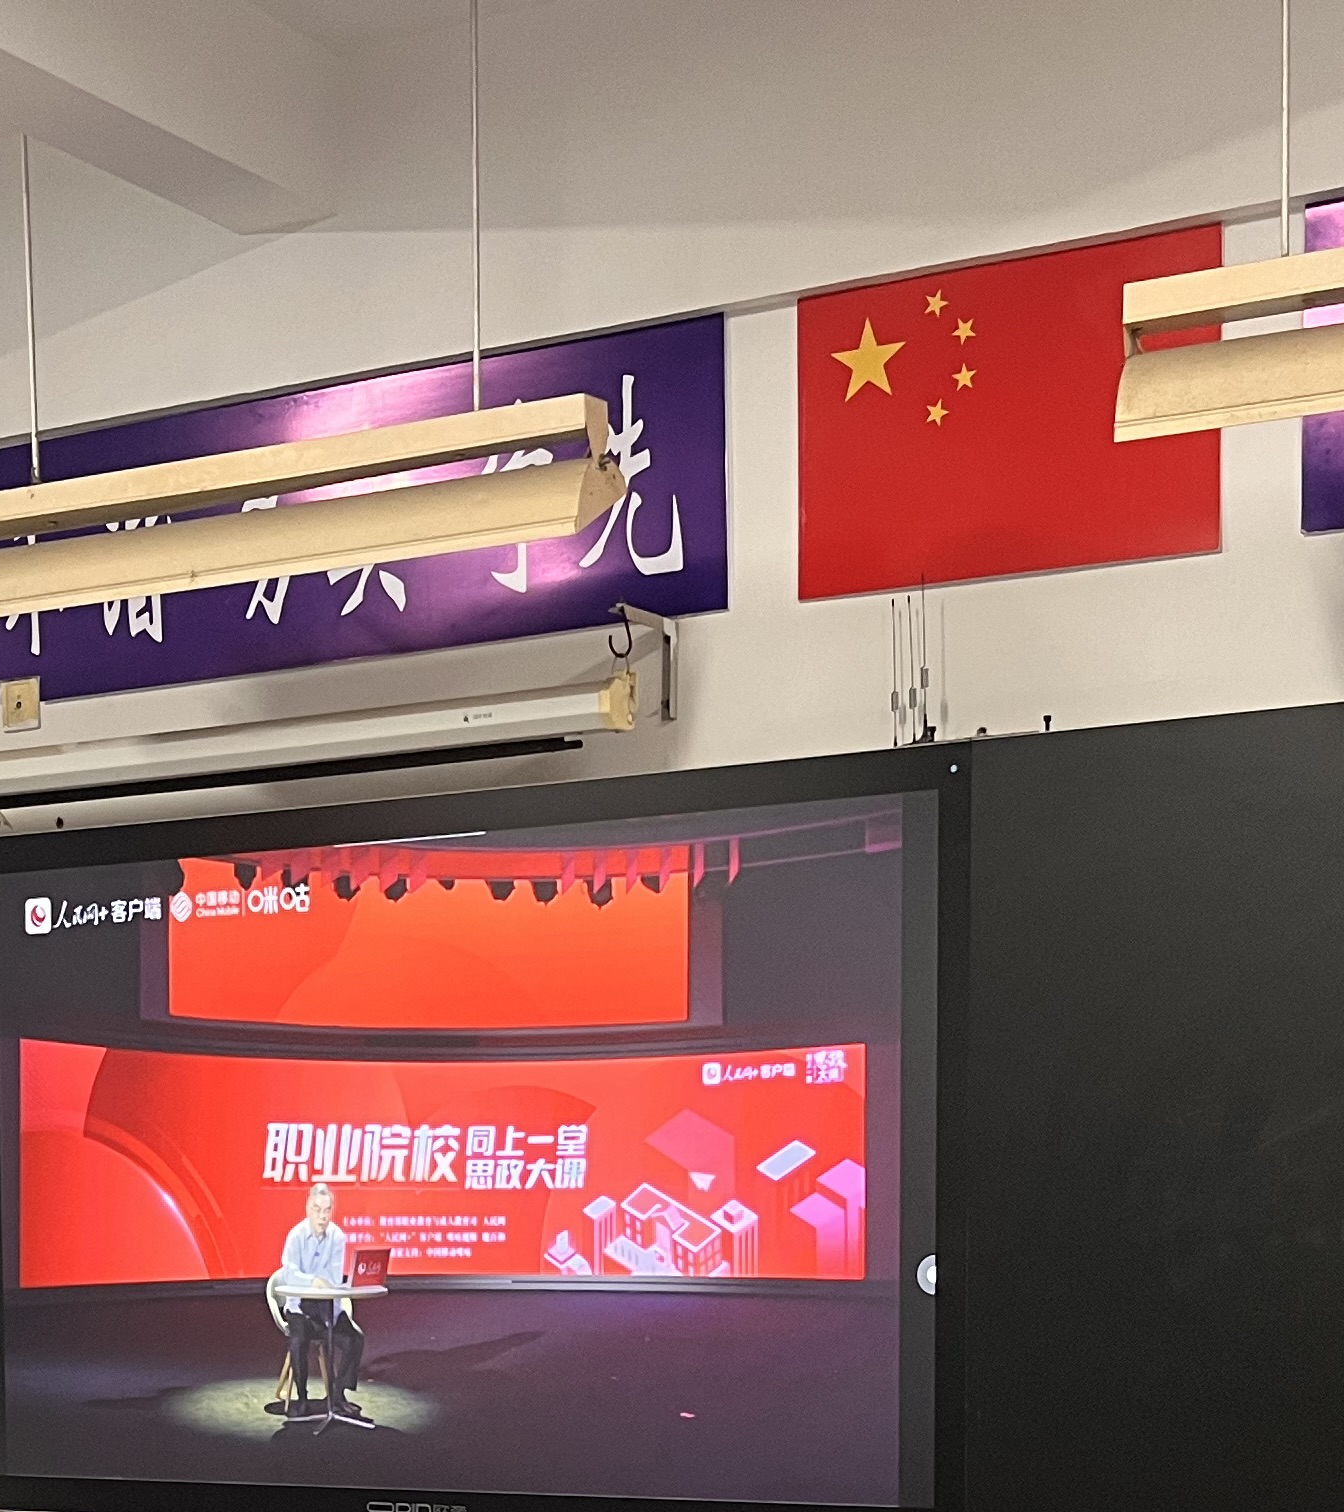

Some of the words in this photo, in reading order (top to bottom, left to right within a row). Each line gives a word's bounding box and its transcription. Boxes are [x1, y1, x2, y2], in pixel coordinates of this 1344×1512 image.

[262, 1122, 460, 1184] 职业院校
[466, 1124, 588, 1157] 同上一堂
[465, 1158, 587, 1190] 思政大课
